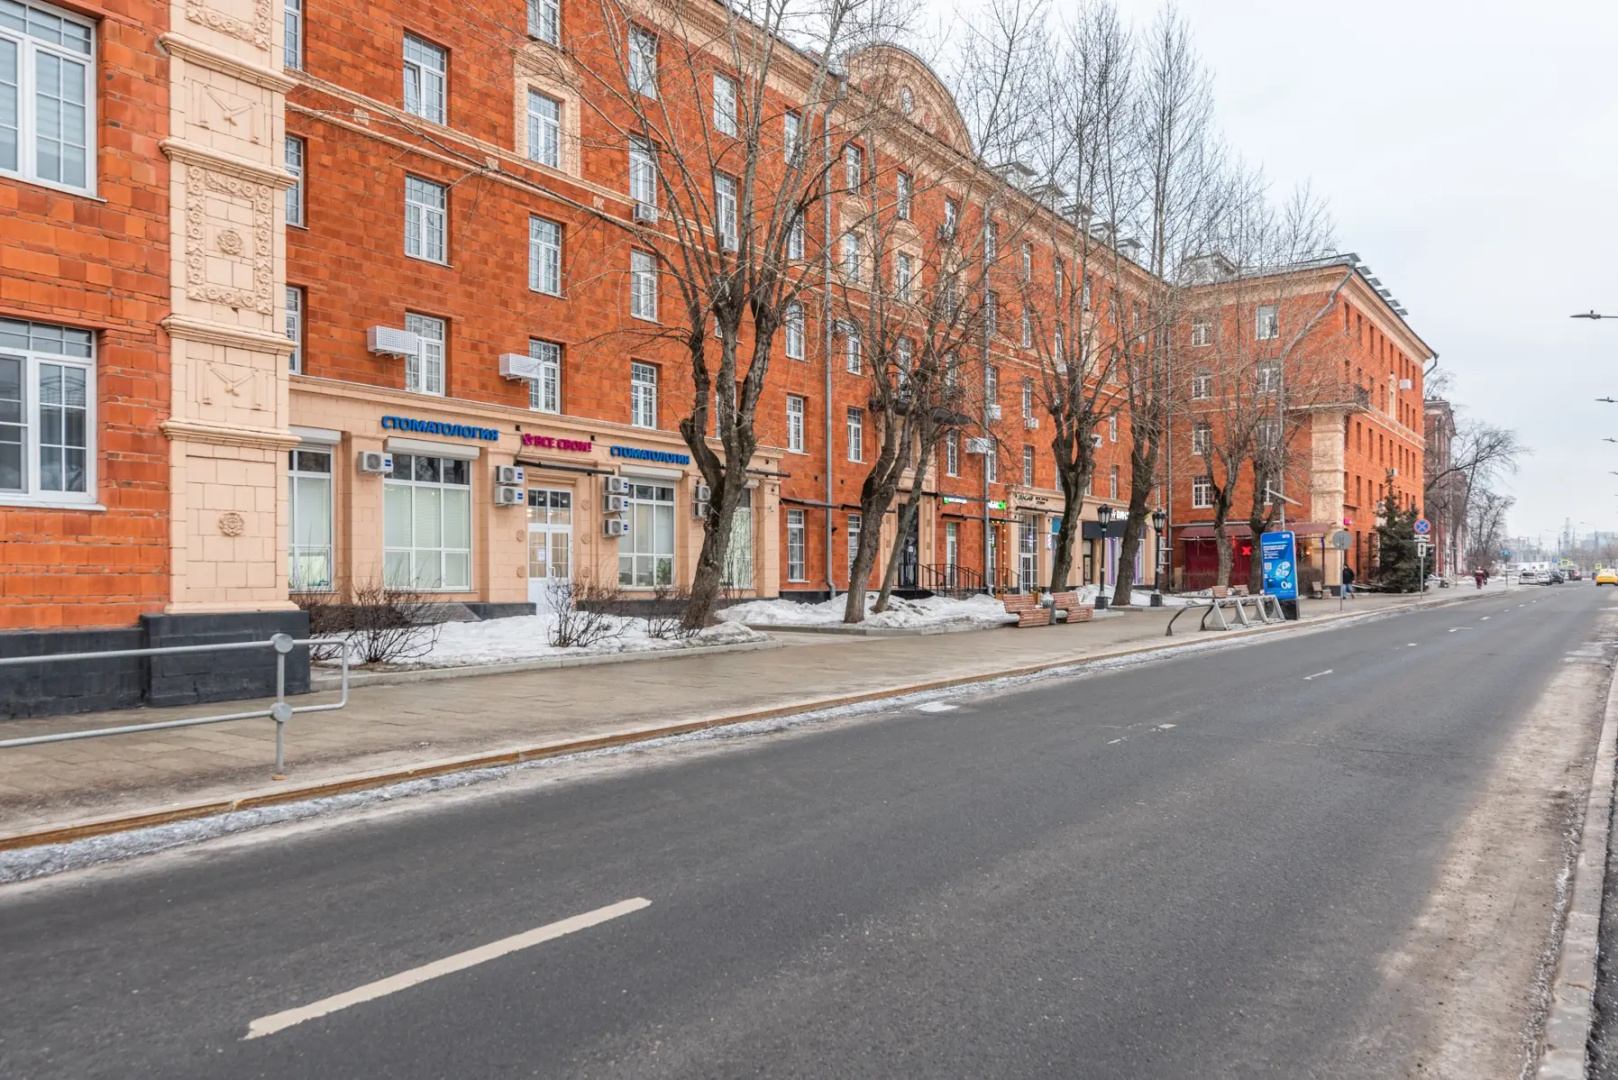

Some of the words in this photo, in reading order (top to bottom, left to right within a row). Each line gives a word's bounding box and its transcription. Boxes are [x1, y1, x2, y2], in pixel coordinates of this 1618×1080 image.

[381, 415, 499, 441] СТОМАТОЛОГИЯ
[534, 435, 556, 449] ВСЕ
[557, 438, 592, 453] СВОИ!
[610, 445, 690, 466] СТОМАТОЛОГИЯ
